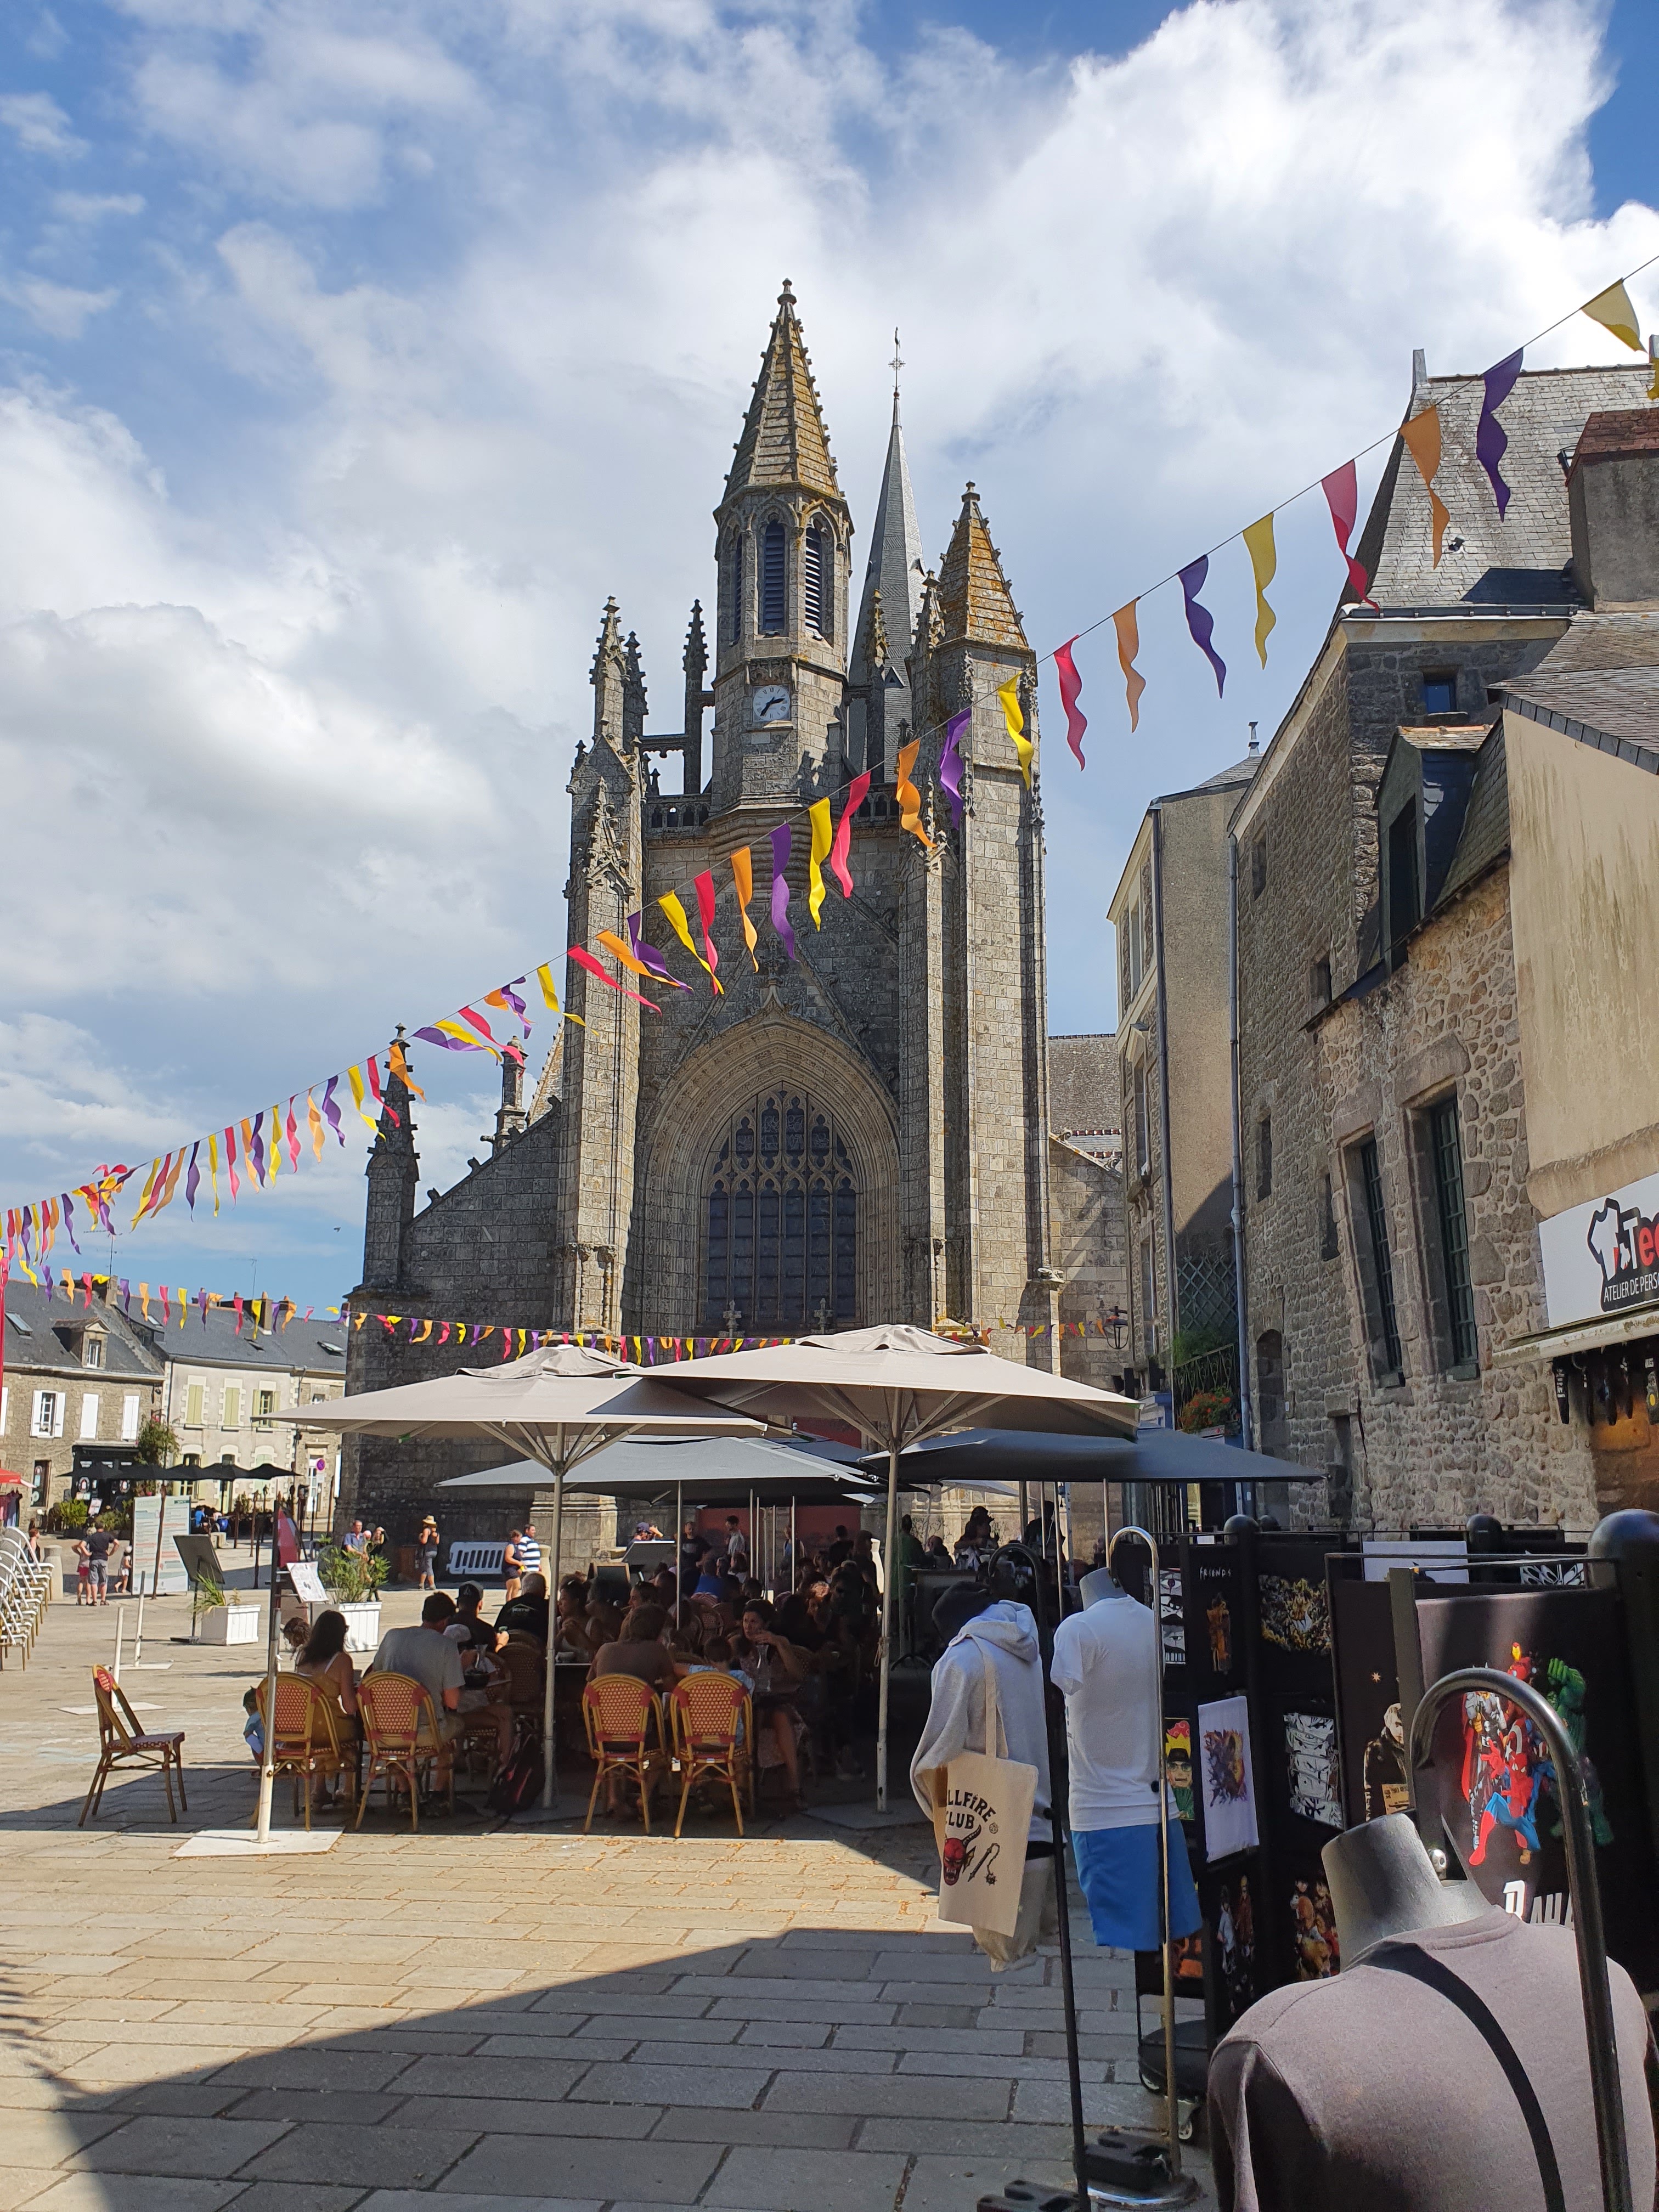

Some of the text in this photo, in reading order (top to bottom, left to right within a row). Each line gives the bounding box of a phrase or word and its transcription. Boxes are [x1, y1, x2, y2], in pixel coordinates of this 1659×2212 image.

[1604, 1272, 1659, 1303] ATELIER DE PERS
[1199, 1566, 1231, 1580] FRIENDS
[946, 1810, 975, 1830] LUB
